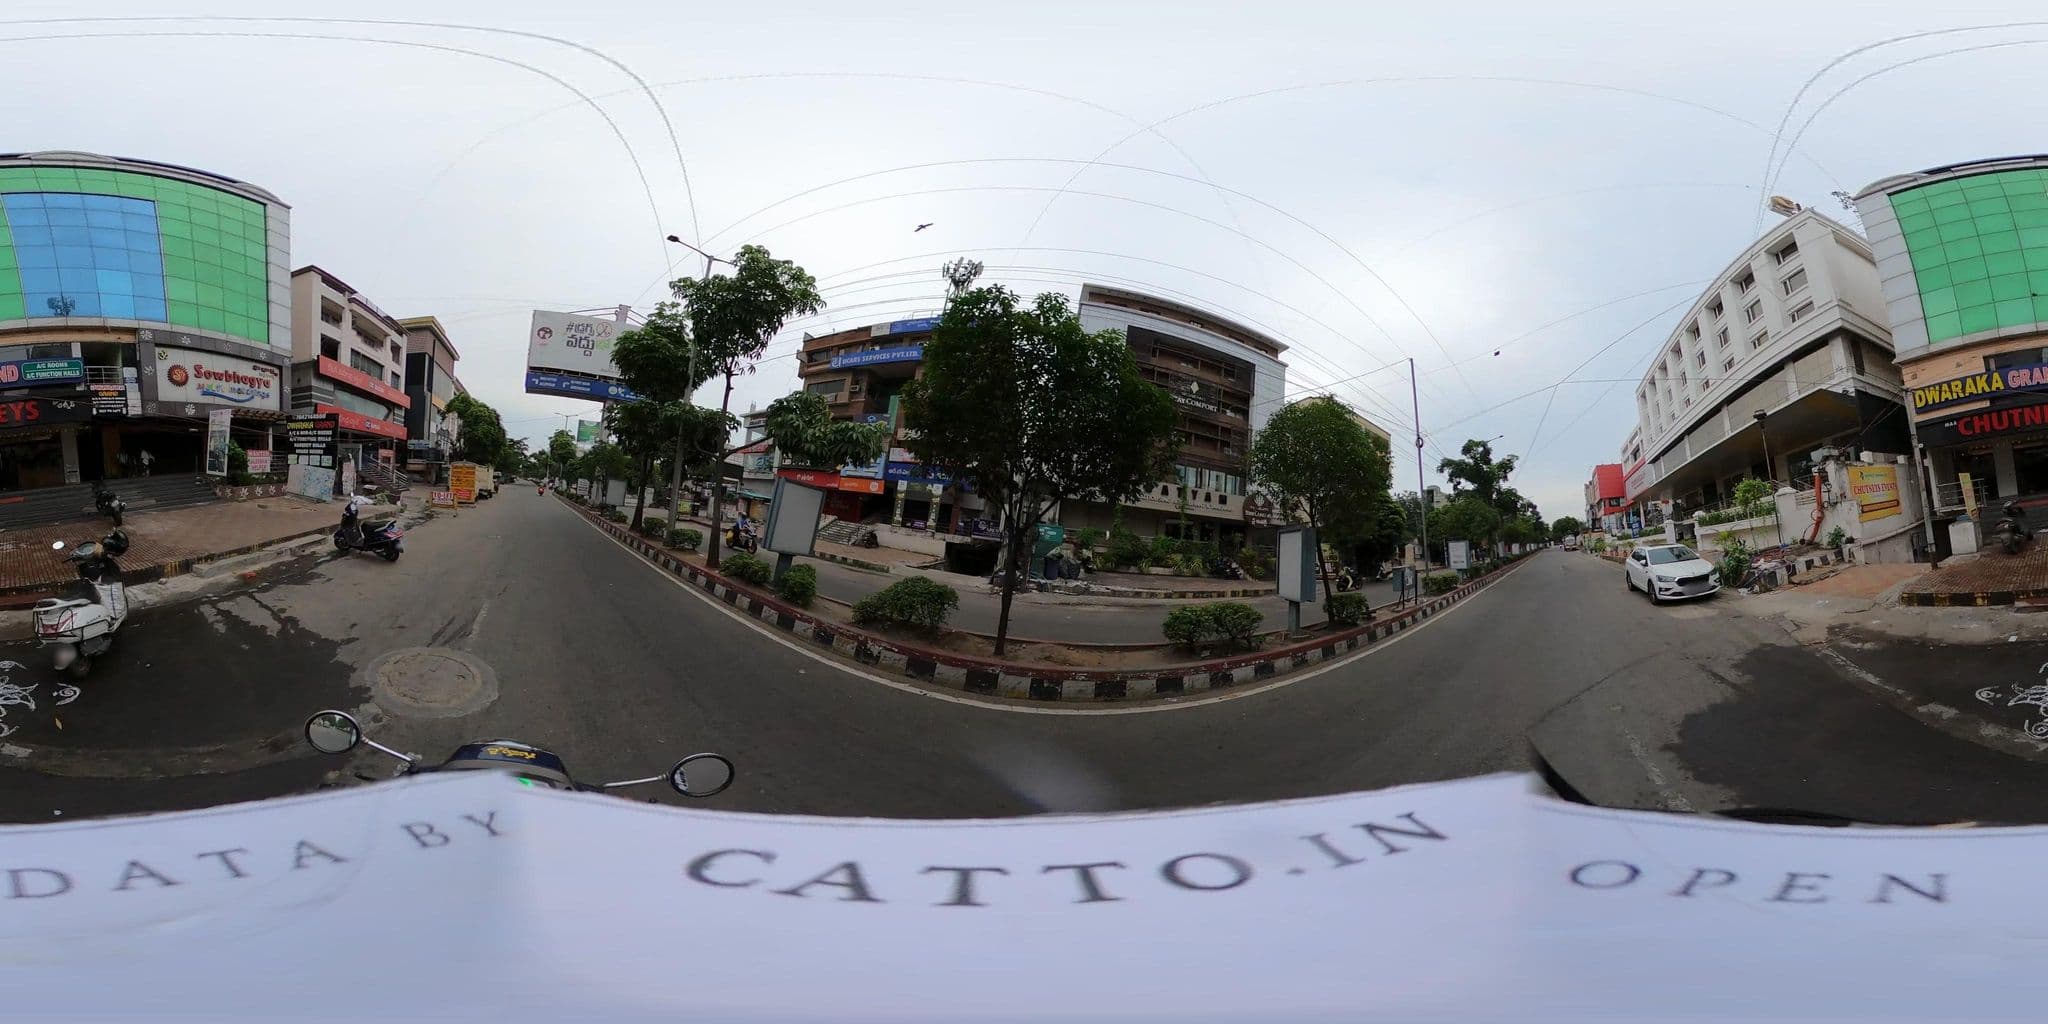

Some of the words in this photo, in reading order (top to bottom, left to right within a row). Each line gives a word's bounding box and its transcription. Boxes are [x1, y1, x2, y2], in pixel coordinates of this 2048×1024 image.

[194, 364, 271, 389] Sowbhagya
[1914, 371, 2005, 408] DWARAKA
[1186, 398, 1218, 412] COMFORT
[7, 839, 350, 900] DATA
[402, 810, 507, 850] BY
[684, 810, 1451, 907] CATTO.IN
[1567, 859, 1952, 905] OPEN
